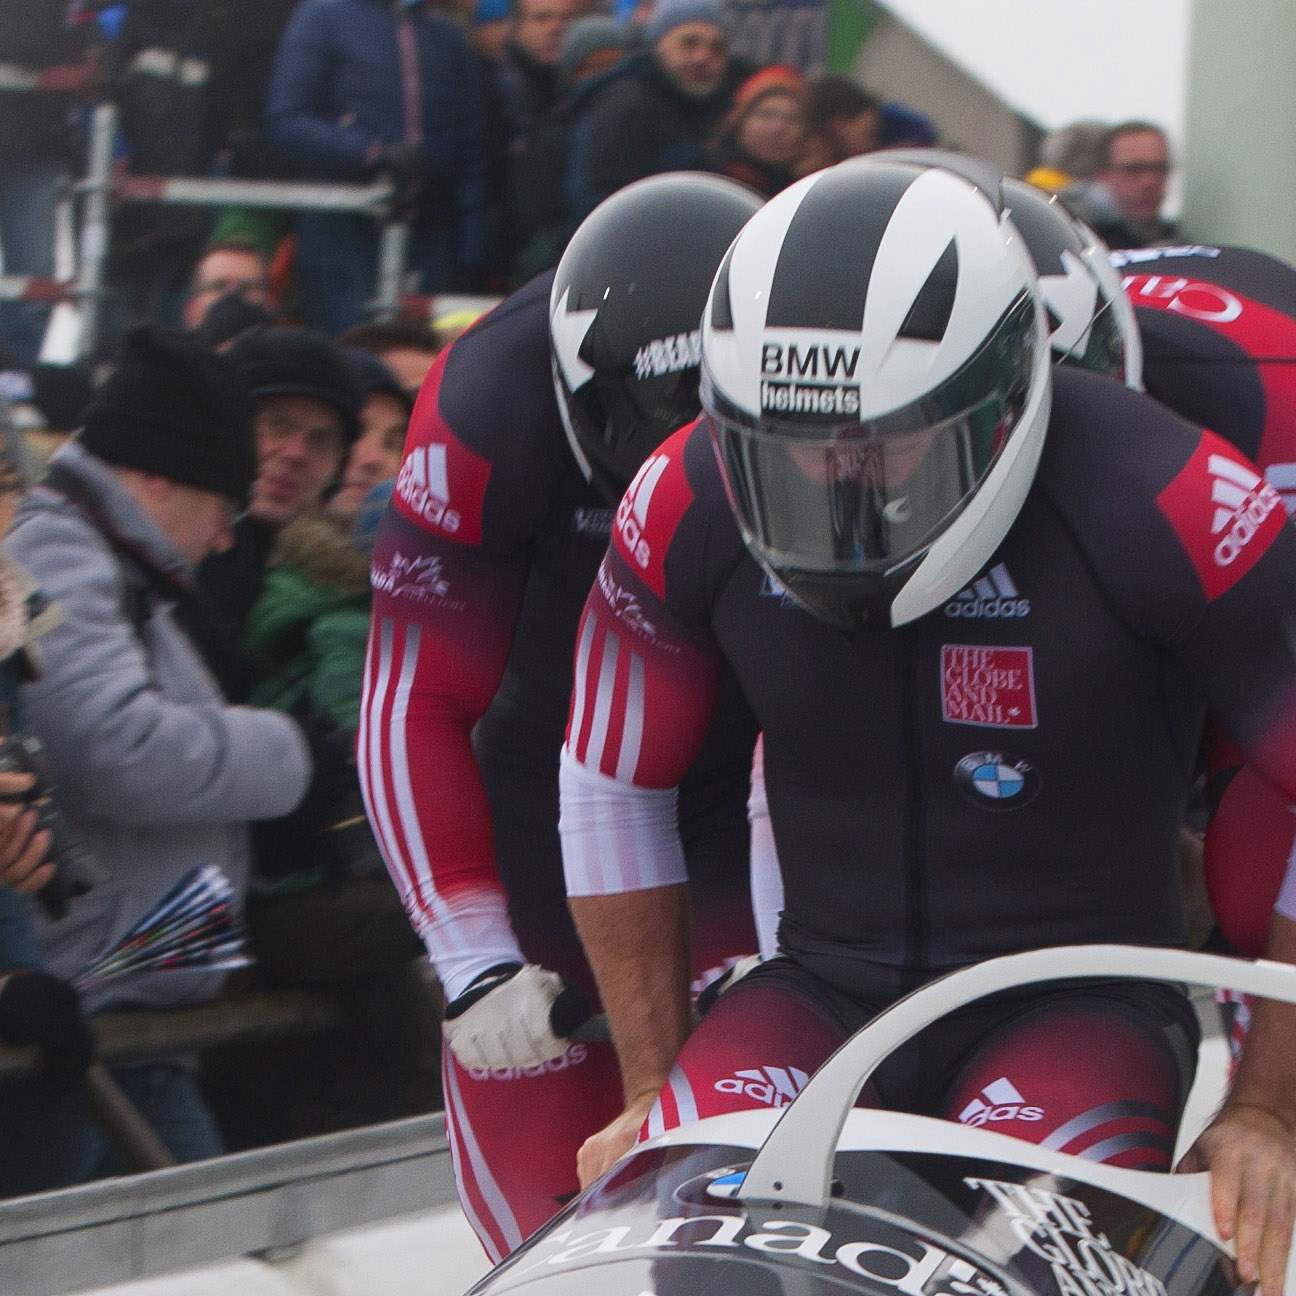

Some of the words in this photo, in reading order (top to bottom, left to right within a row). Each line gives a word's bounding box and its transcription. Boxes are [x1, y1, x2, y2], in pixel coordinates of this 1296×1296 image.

[761, 344, 861, 379] BMW
[761, 380, 861, 415] helmets
[616, 494, 652, 569] das
[1213, 483, 1282, 567] adidas
[944, 597, 1032, 619] adidas
[945, 648, 996, 670] THE
[945, 666, 1024, 691] GLOBE
[945, 682, 999, 706] AND
[946, 700, 1011, 725] MAIL
[713, 1078, 792, 1109] adi
[966, 1105, 1045, 1129] das
[962, 1176, 1112, 1250] THE
